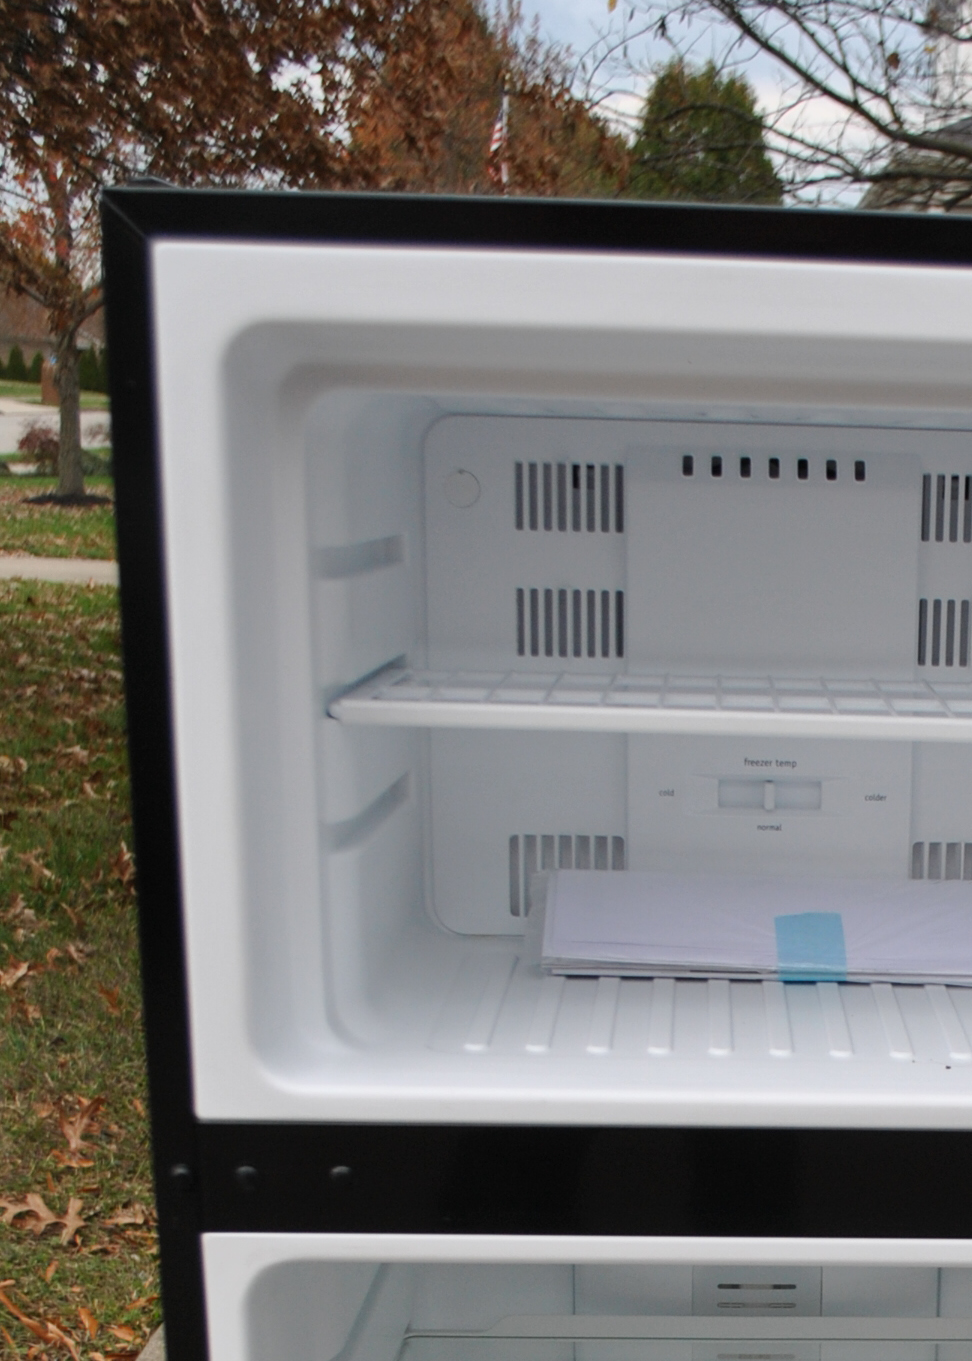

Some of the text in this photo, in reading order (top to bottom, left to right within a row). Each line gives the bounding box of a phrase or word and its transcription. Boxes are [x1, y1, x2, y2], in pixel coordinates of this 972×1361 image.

[744, 757, 797, 769] freezer temp
[658, 788, 675, 797] cold
[864, 793, 887, 802] colder
[756, 824, 782, 832] normal
